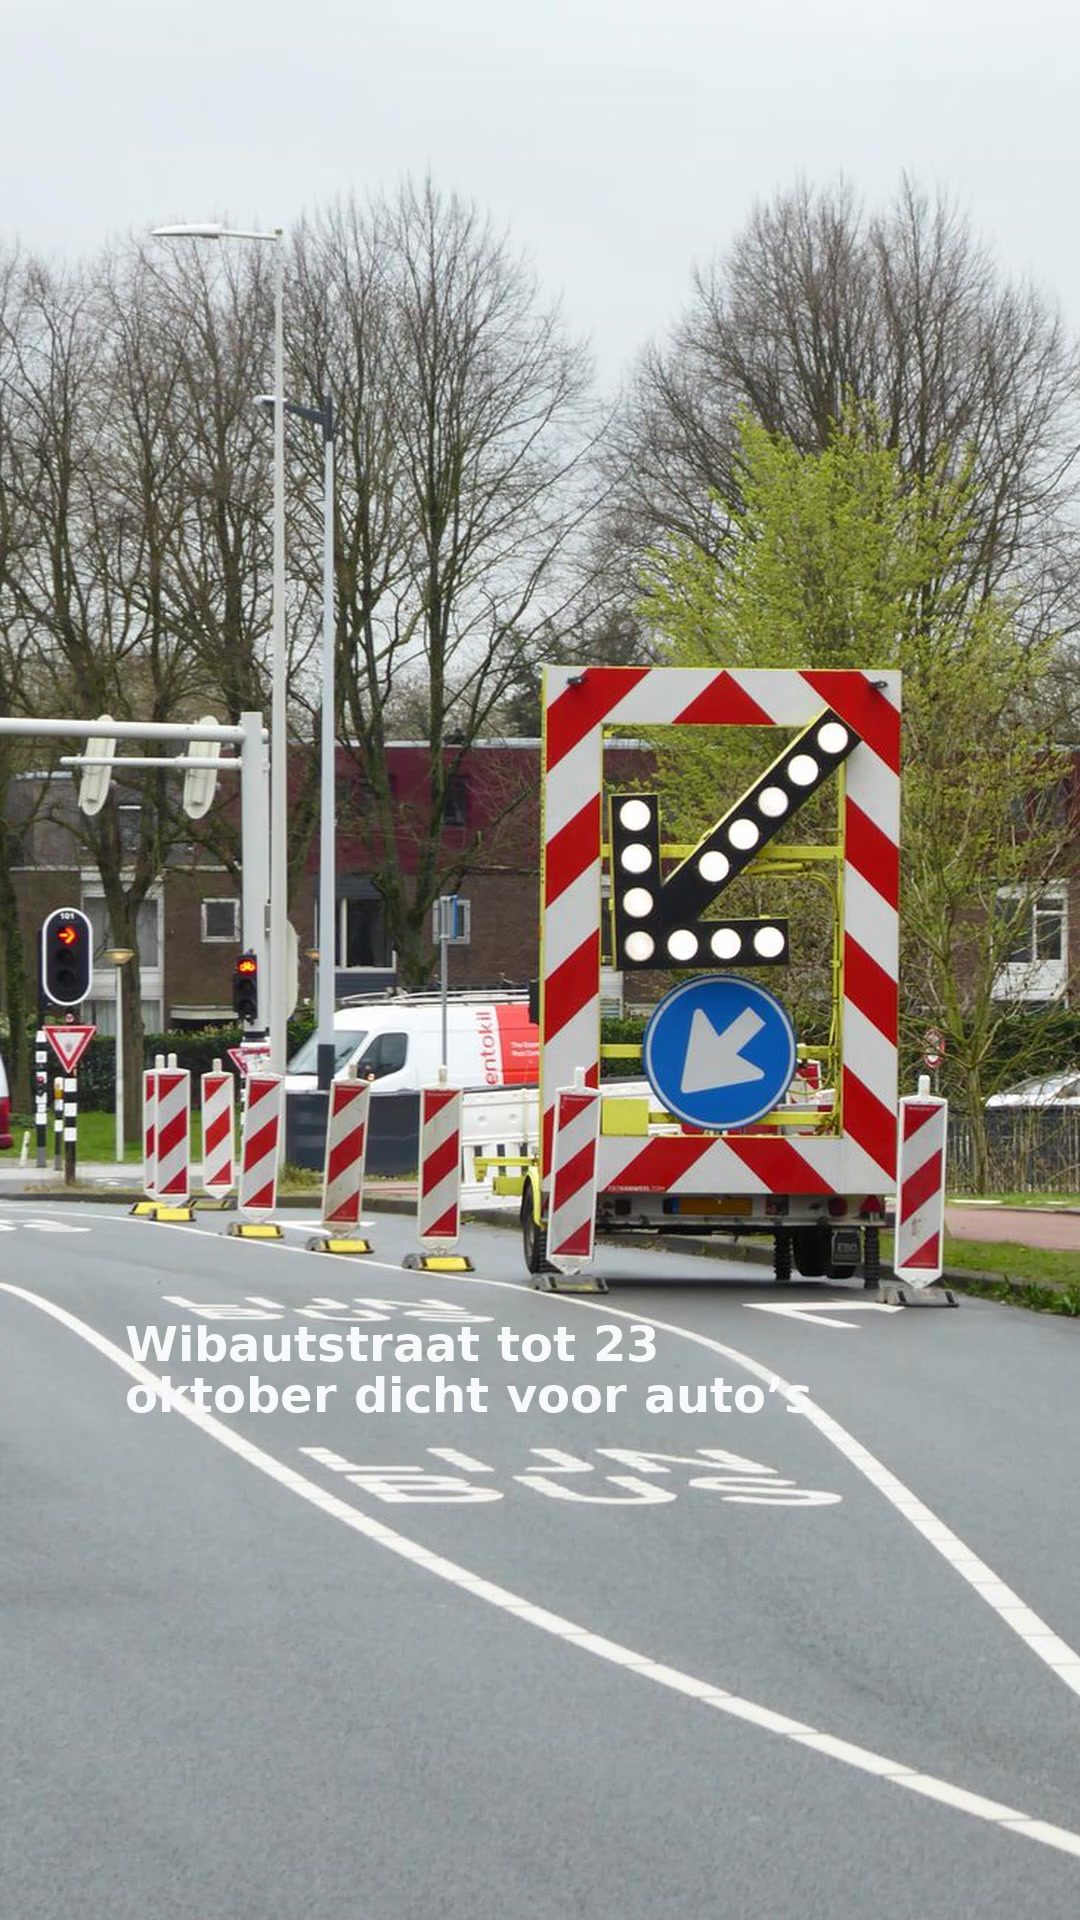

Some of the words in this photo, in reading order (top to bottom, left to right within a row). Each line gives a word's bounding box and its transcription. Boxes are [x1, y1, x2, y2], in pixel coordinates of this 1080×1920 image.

[60, 912, 75, 920] 101
[160, 1296, 465, 1310] LIJN
[188, 1307, 495, 1323] BUS
[299, 1447, 778, 1473] LIJN
[346, 1475, 843, 1505] BUS
